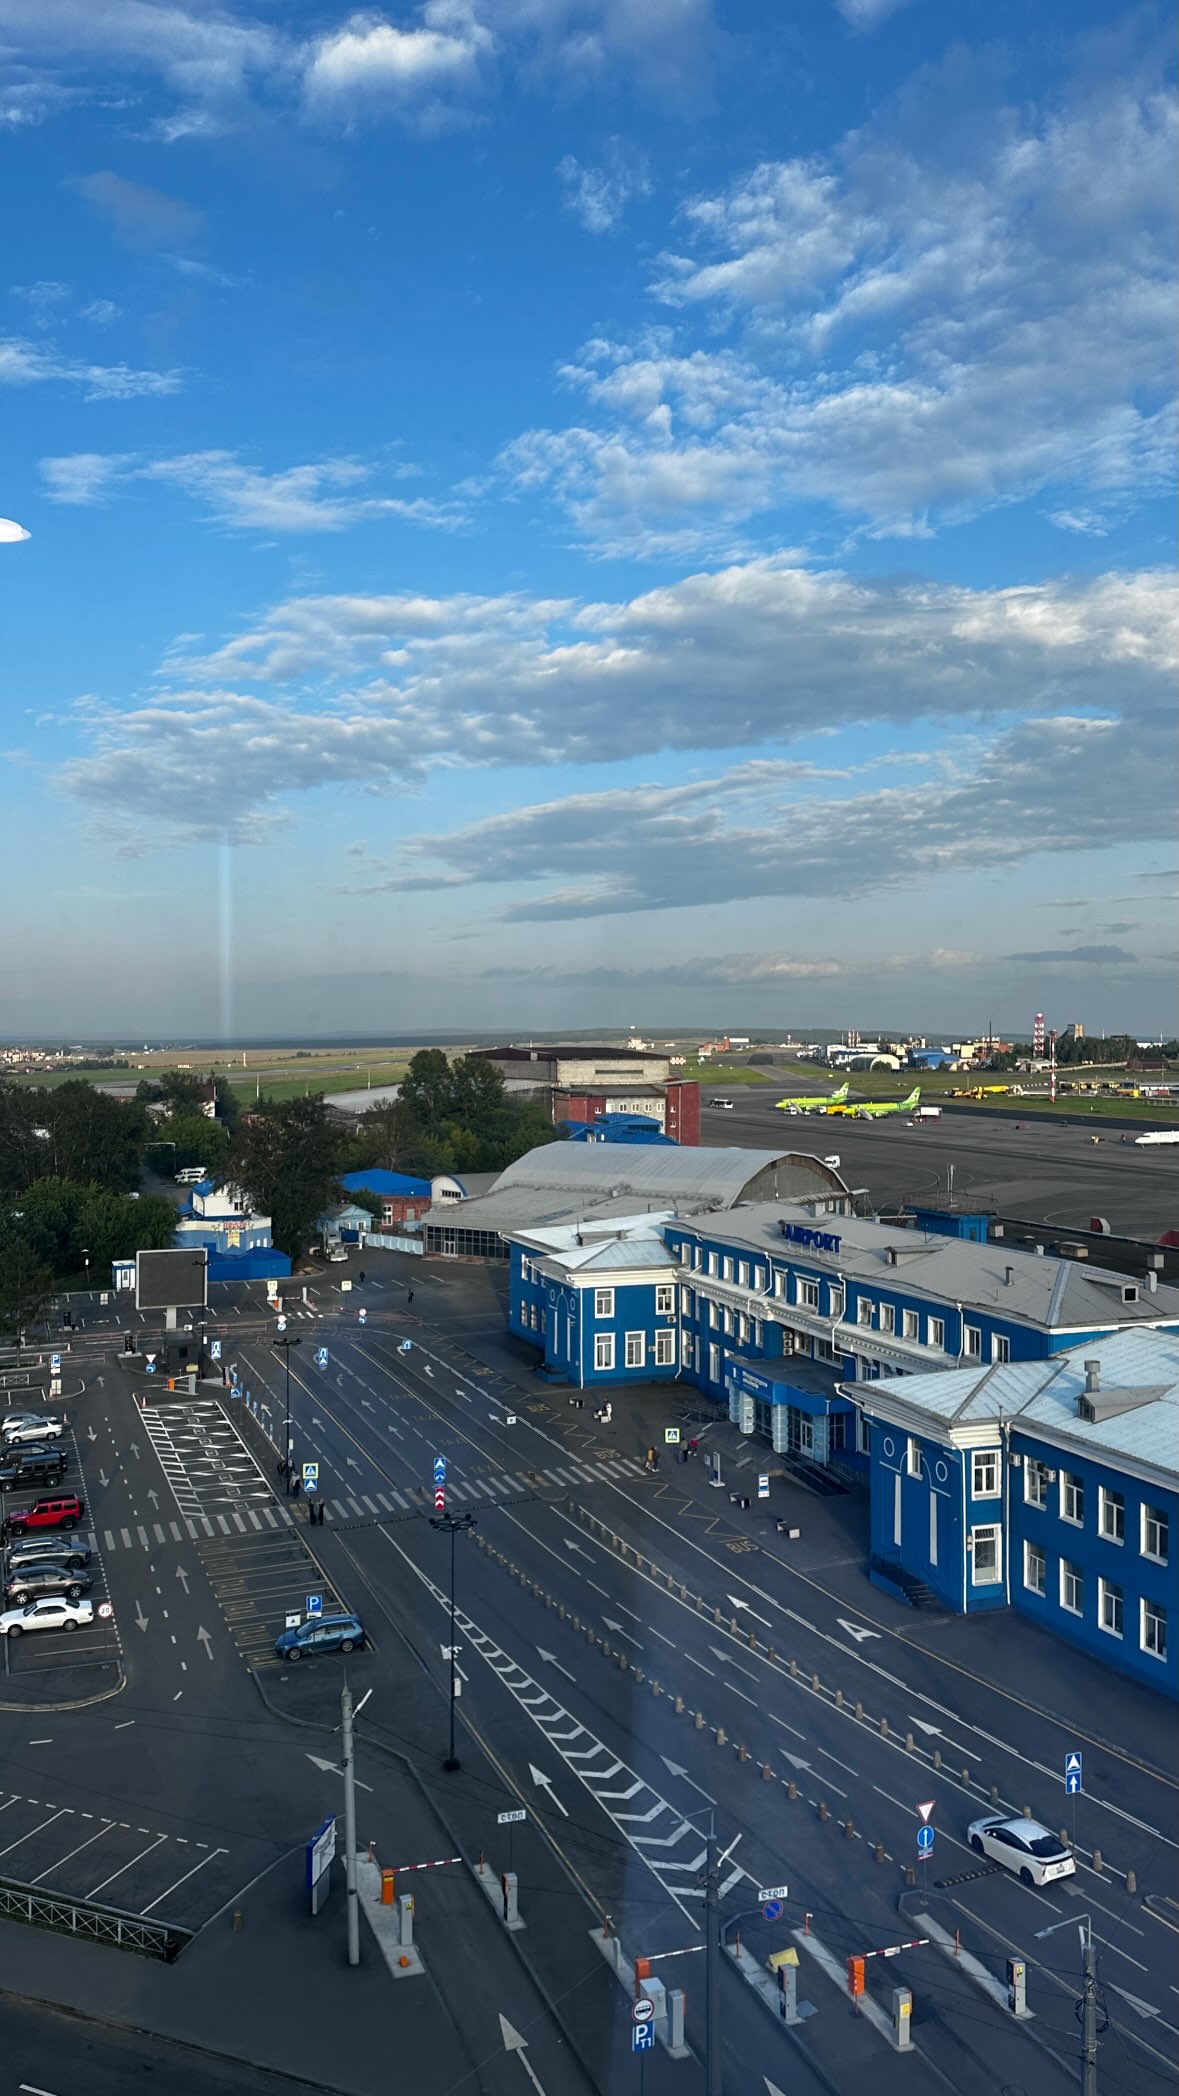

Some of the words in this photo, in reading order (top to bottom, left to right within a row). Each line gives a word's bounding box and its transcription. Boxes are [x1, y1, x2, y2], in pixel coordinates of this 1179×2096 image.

[784, 1223, 842, 1253] AIRPORT
[725, 1541, 759, 1553] BUS
[310, 1596, 319, 1610] P
[836, 1618, 882, 1642] A
[635, 2023, 648, 2045] P
